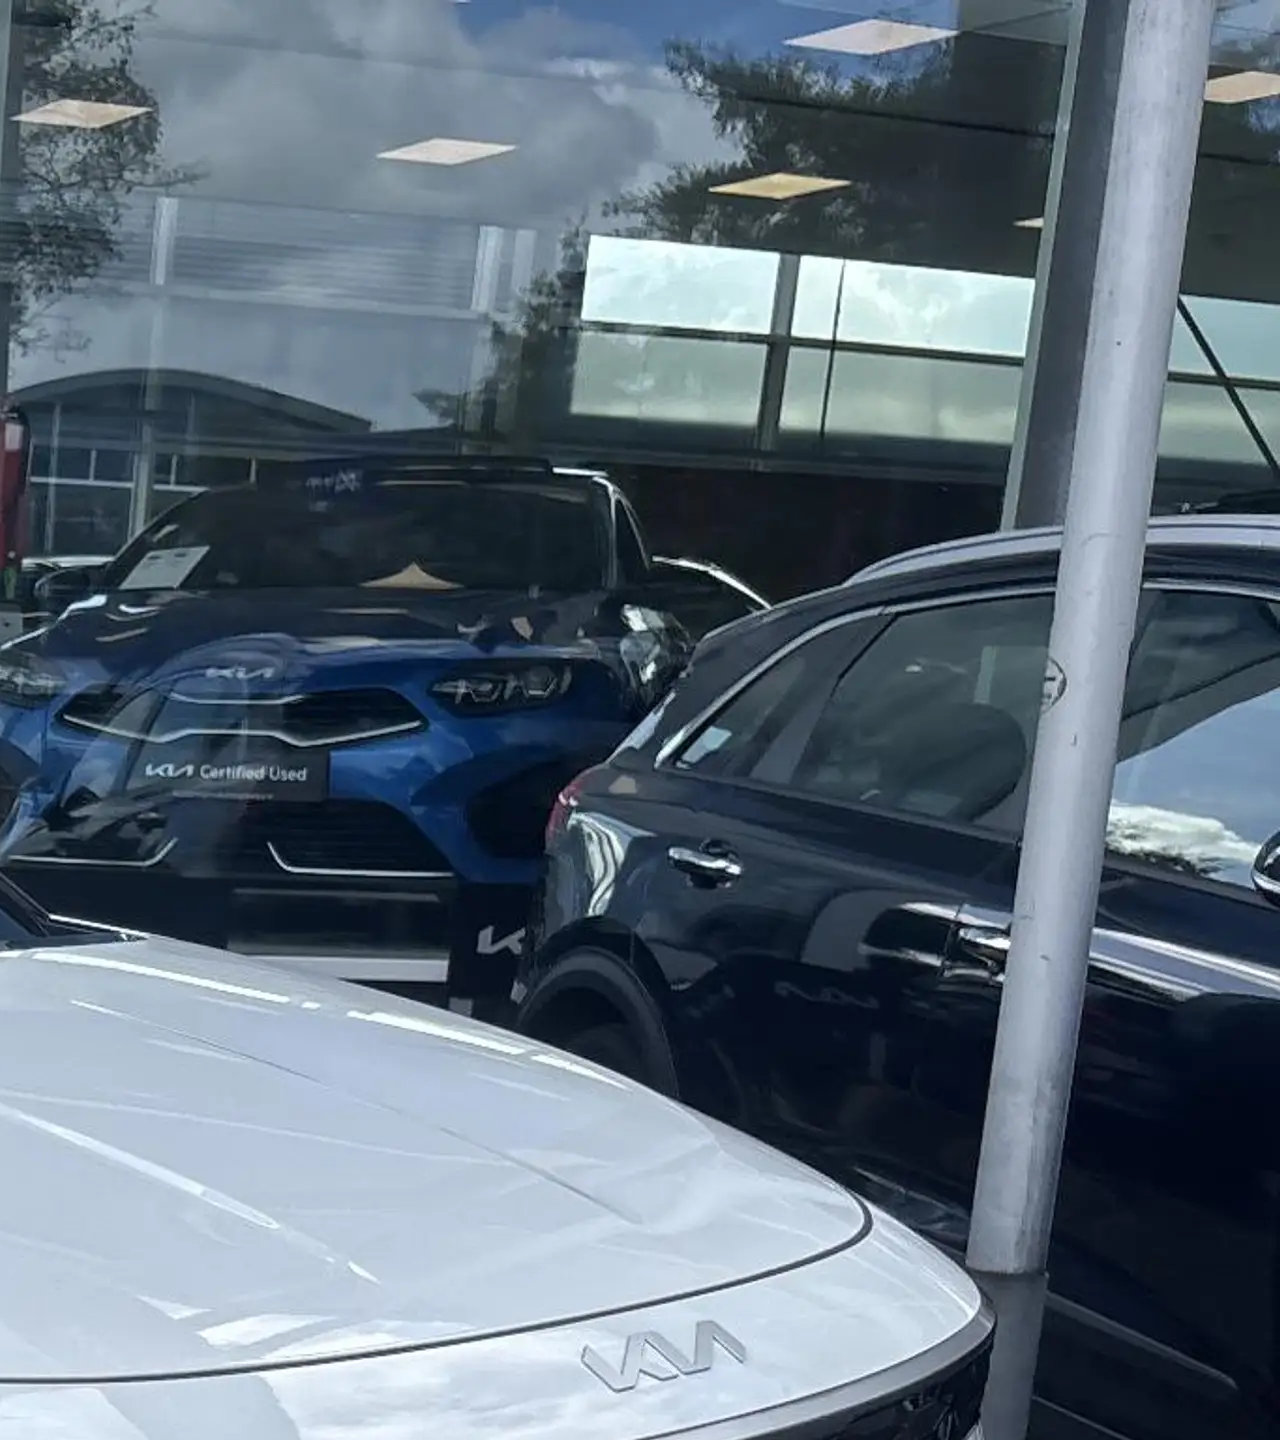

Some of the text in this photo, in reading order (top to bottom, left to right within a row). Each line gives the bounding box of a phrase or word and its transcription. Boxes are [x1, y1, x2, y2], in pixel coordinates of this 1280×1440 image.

[145, 762, 307, 781] KIA Certified Used
[581, 1319, 747, 1394] KIA
